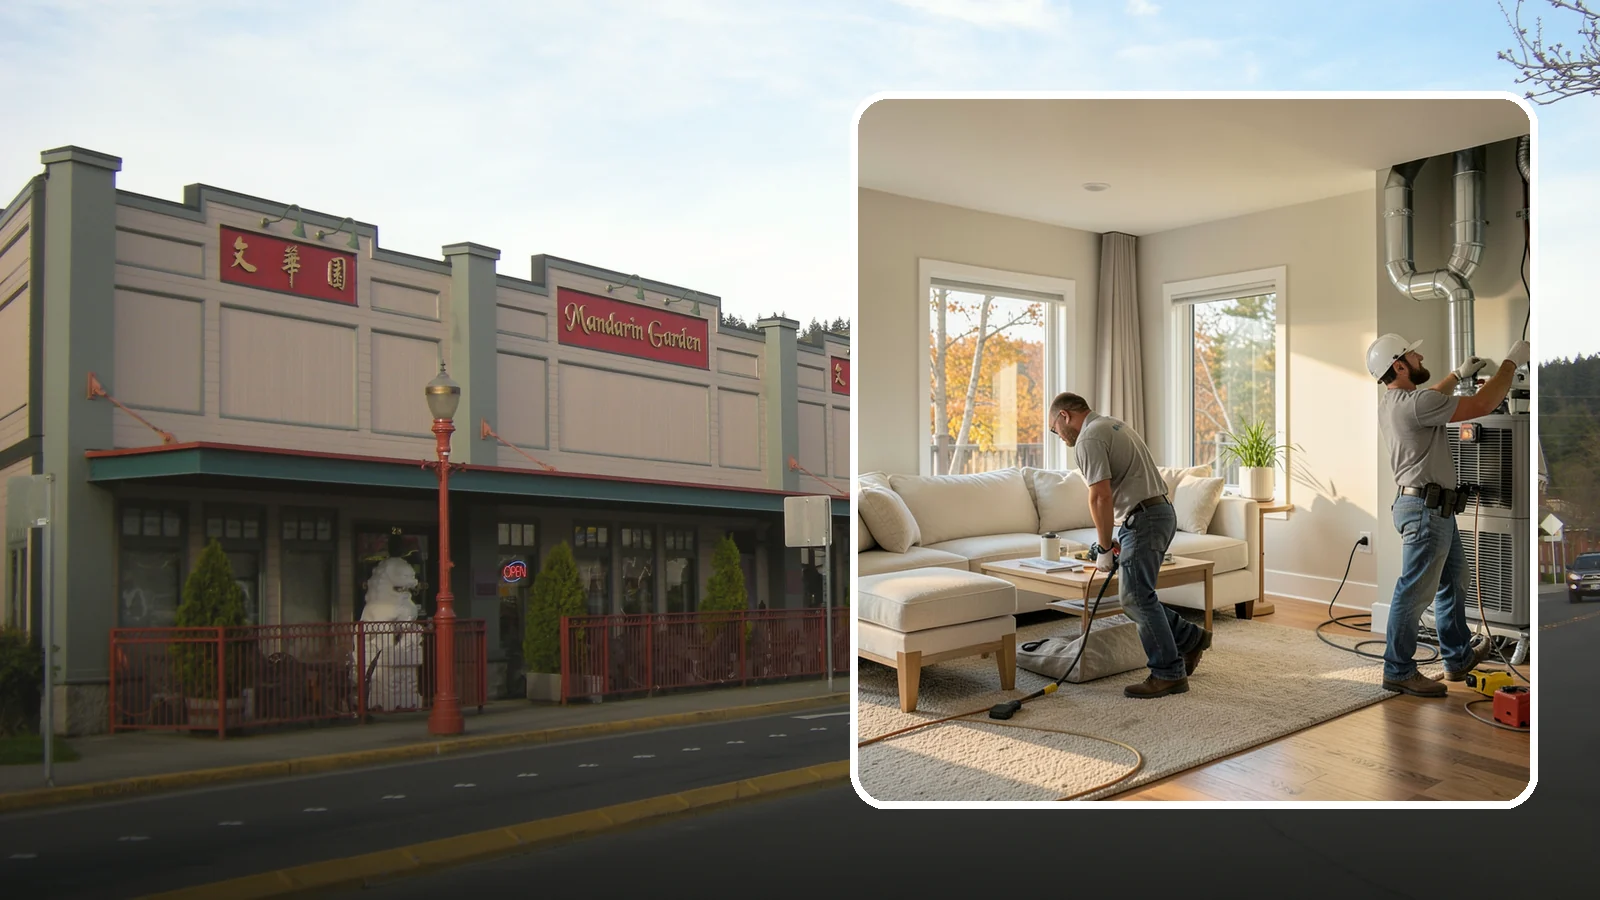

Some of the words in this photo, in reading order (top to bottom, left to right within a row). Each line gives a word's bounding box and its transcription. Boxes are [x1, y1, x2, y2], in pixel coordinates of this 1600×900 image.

[231, 236, 346, 291] 文華園
[564, 302, 644, 340] Mandarin
[648, 320, 701, 352] Garden
[503, 565, 527, 578] OPEN
